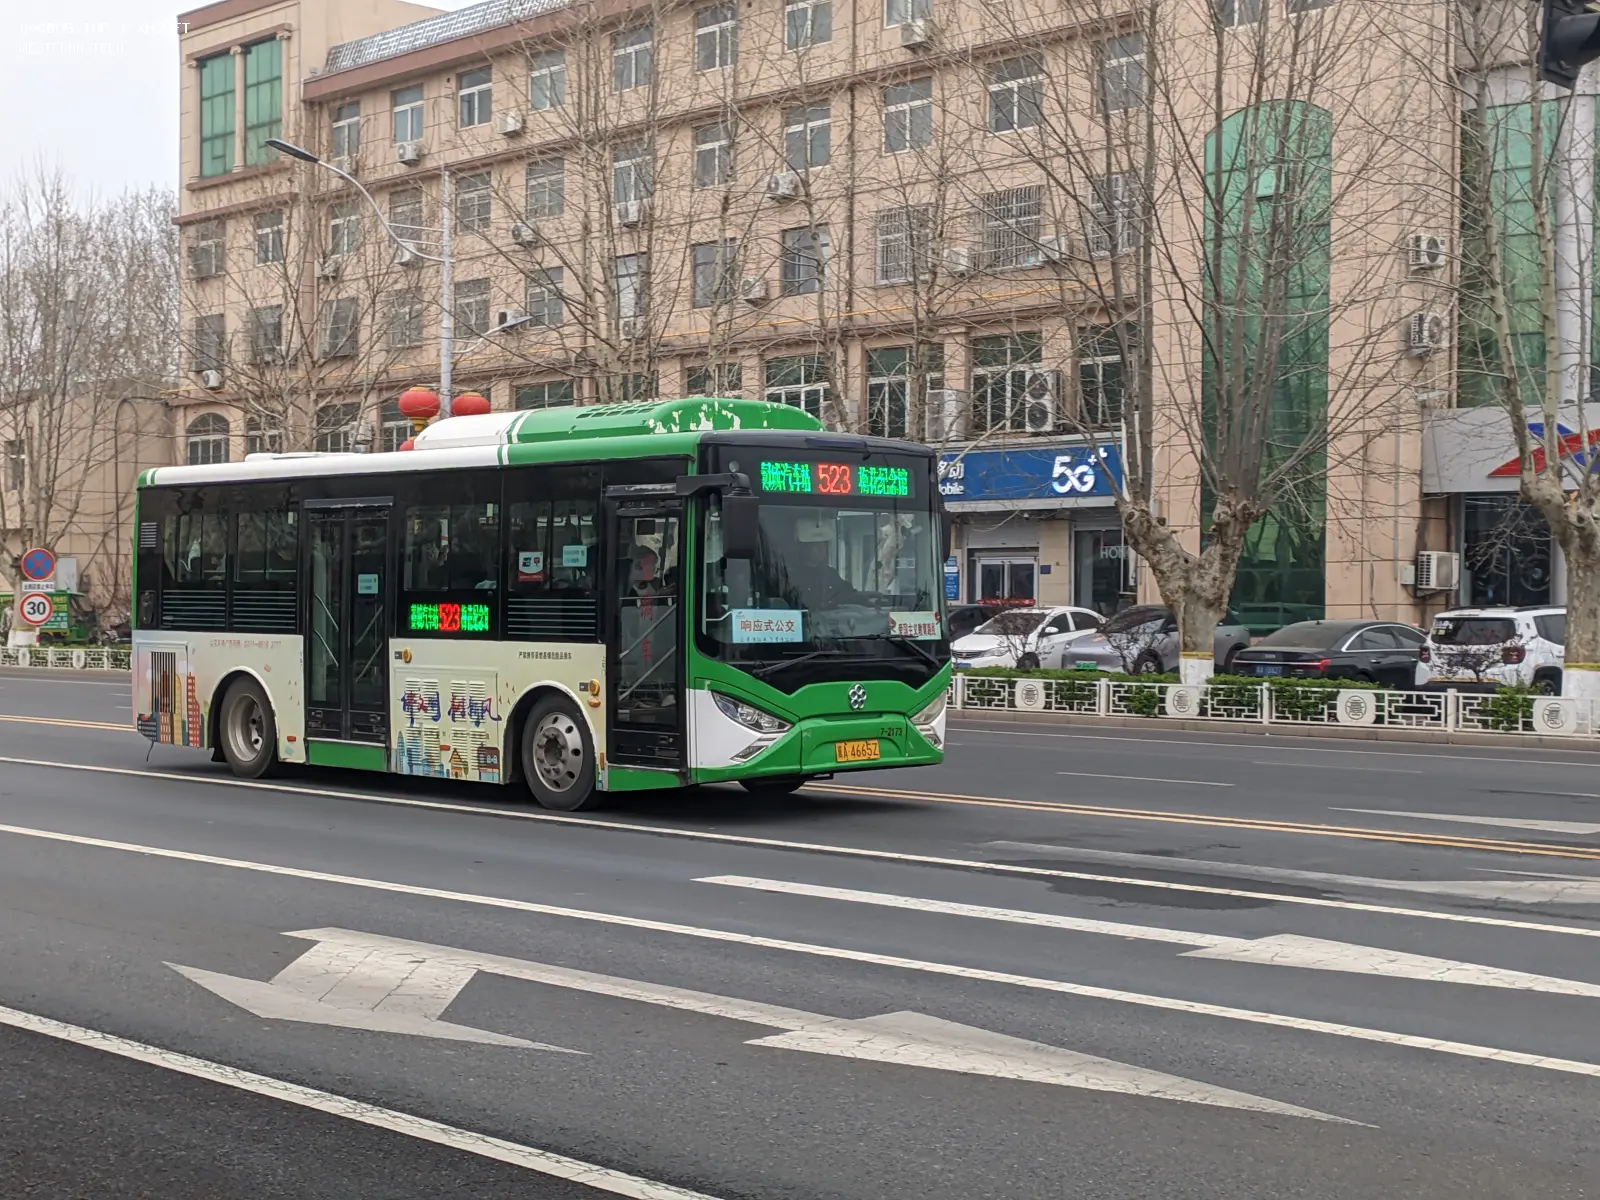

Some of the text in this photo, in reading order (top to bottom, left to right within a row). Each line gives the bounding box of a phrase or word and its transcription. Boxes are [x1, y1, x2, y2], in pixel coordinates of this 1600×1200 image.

[817, 462, 852, 494] 523
[938, 483, 965, 496] obile
[26, 601, 46, 615] 30
[438, 603, 461, 632] 523
[740, 619, 796, 633] 响应式公交
[880, 727, 903, 738] 7-2173
